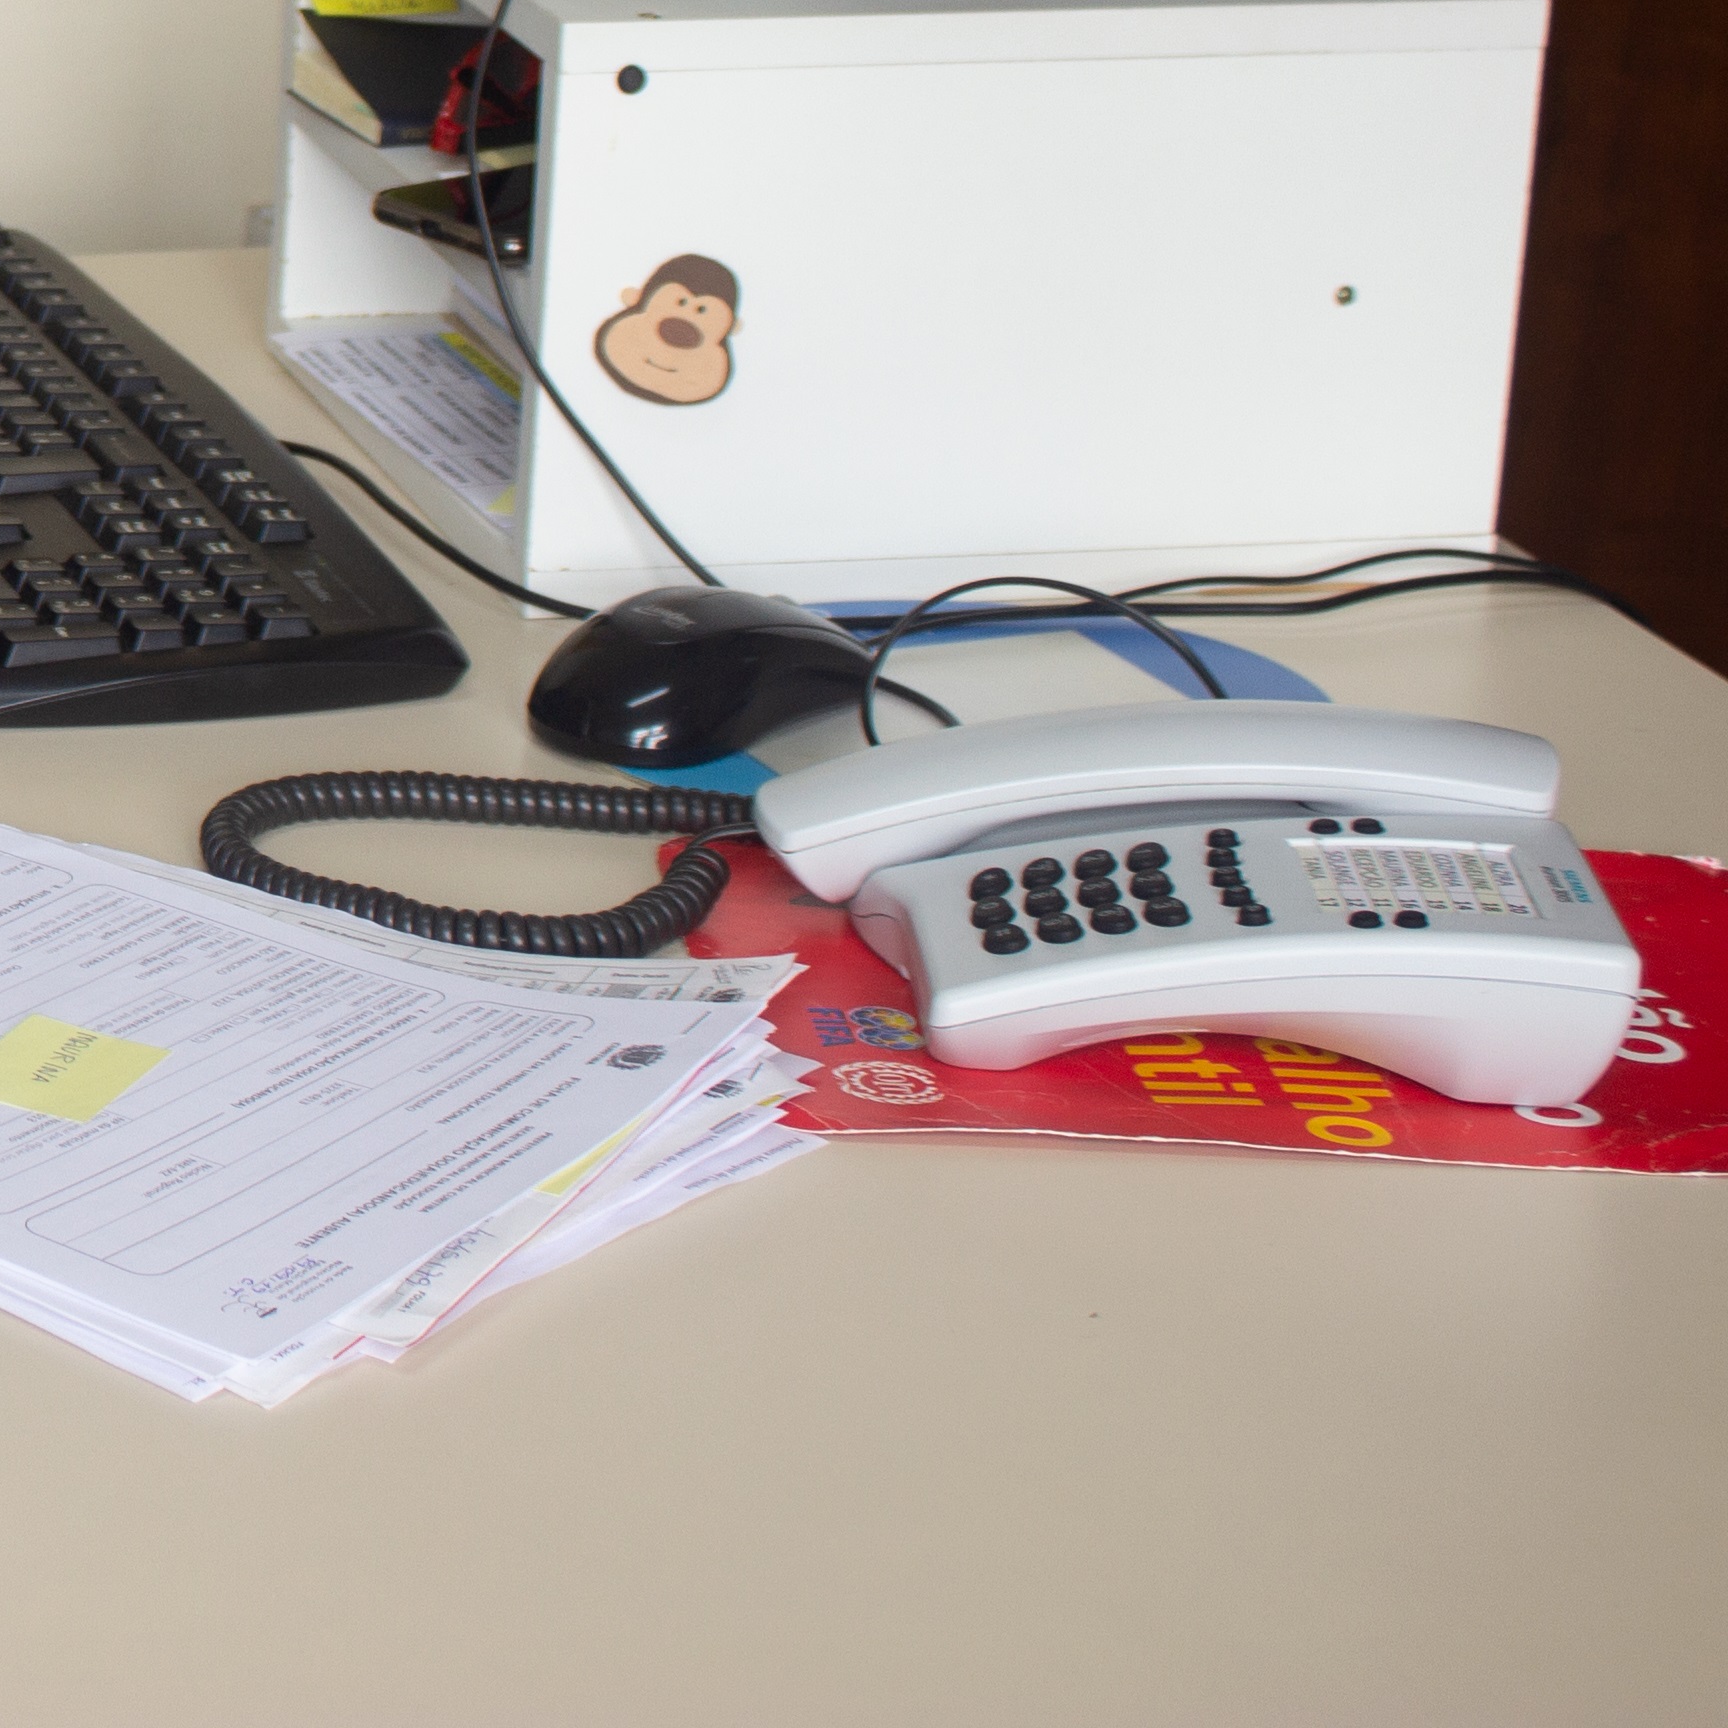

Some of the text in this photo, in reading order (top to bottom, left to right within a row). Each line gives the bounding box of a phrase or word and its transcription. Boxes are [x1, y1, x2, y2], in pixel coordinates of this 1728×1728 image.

[1300, 857, 1340, 908] TANIA 17
[1324, 850, 1368, 908] SOLANGE 12
[1349, 849, 1395, 907] RECEPÇÃO 11
[1379, 850, 1421, 909] MAURINA 16
[1404, 850, 1449, 910] EDUARDO 19
[1432, 853, 1476, 911] COZINHA 14
[1457, 853, 1503, 912] ANGELINE 18
[1487, 861, 1530, 915] ALZIRA 20
[1560, 868, 1597, 904] SIEMENS
[4, 889, 53, 910] SITUAÇÃO
[338, 1009, 375, 1026] GARCIA
[369, 1028, 391, 1037] DE
[381, 1013, 419, 1031] DADOS
[524, 1017, 564, 1038] ESCOLA
[805, 1005, 857, 1048] FIFA
[29, 1030, 97, 1084] MAURINA
[310, 1034, 379, 1067] IDENTIFICAÇÃO
[482, 1035, 534, 1064] MUNICIPAL
[521, 1059, 545, 1070] DA
[535, 1041, 574, 1062] DADOS
[582, 1040, 624, 1066] CURITIBA
[438, 1061, 492, 1091] PROFESSOR
[486, 1067, 532, 1093] UNIDADE
[1124, 1034, 1264, 1106] ntil
[229, 1077, 296, 1109] EDUCANDO(A)
[521, 1095, 550, 1108] DE
[537, 1074, 584, 1099] FICHA
[1253, 1038, 1393, 1147] alho
[434, 1090, 496, 1126] EDUCACIONAL
[444, 1105, 534, 1156] COMUNICAÇÃO
[175, 1161, 214, 1180] Núcleo
[389, 1123, 538, 1212] SECRETARIA MUNICIPAL DA EDUCAÇÃO
[415, 1130, 556, 1215] PREFEITURA MUNICIPAL DE CURITIBA
[291, 1215, 355, 1250] AUSENTE
[315, 1258, 346, 1275] Núcleo
[318, 1274, 338, 1284] de
[399, 1288, 427, 1309] FOLHA
[275, 1339, 307, 1358] FOLHA
